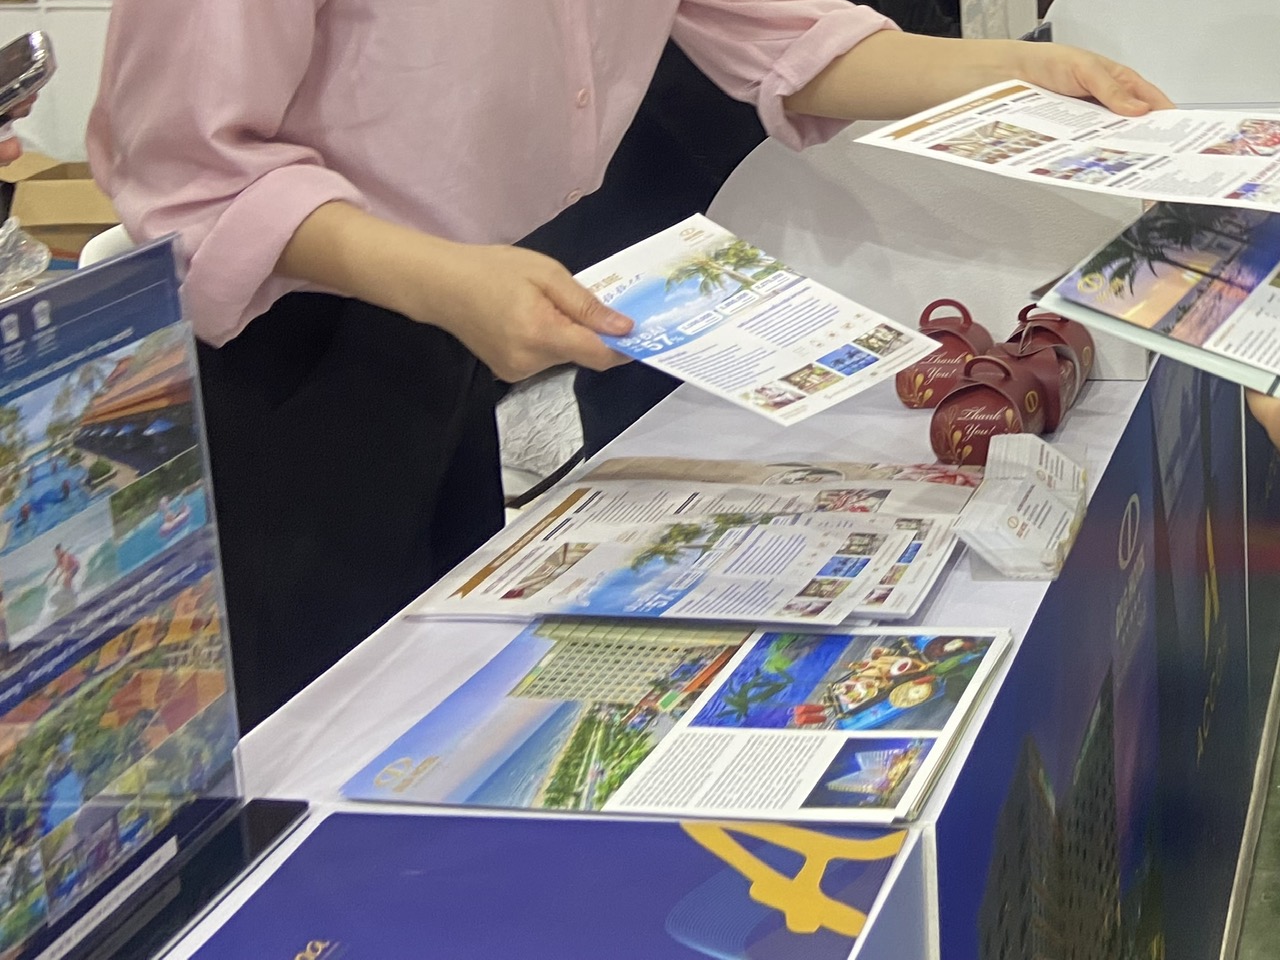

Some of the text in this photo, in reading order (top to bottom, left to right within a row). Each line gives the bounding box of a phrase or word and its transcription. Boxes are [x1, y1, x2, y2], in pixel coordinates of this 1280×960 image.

[920, 351, 969, 365] Thank
[923, 366, 957, 386] You!
[957, 405, 1008, 421] Thank
[962, 423, 997, 442] You!
